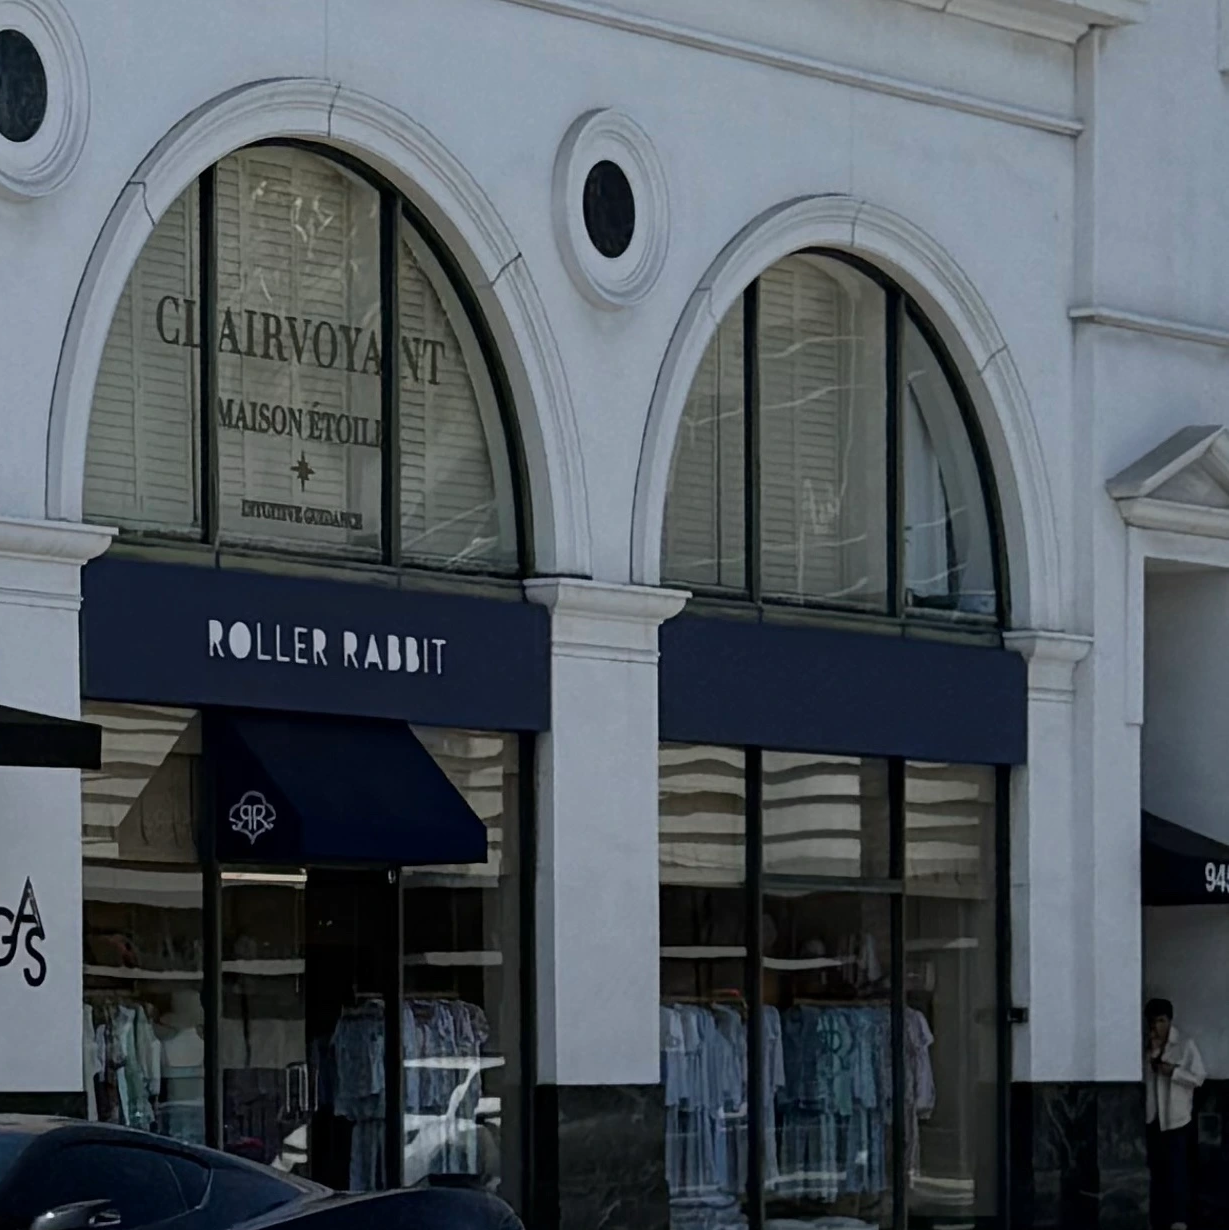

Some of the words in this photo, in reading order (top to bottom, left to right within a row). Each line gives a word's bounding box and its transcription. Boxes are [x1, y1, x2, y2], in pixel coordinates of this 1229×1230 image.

[218, 397, 303, 441] MAISON
[208, 619, 328, 667] ROLLER
[343, 630, 447, 675] RABBIT
[1205, 862, 1229, 893] 94
